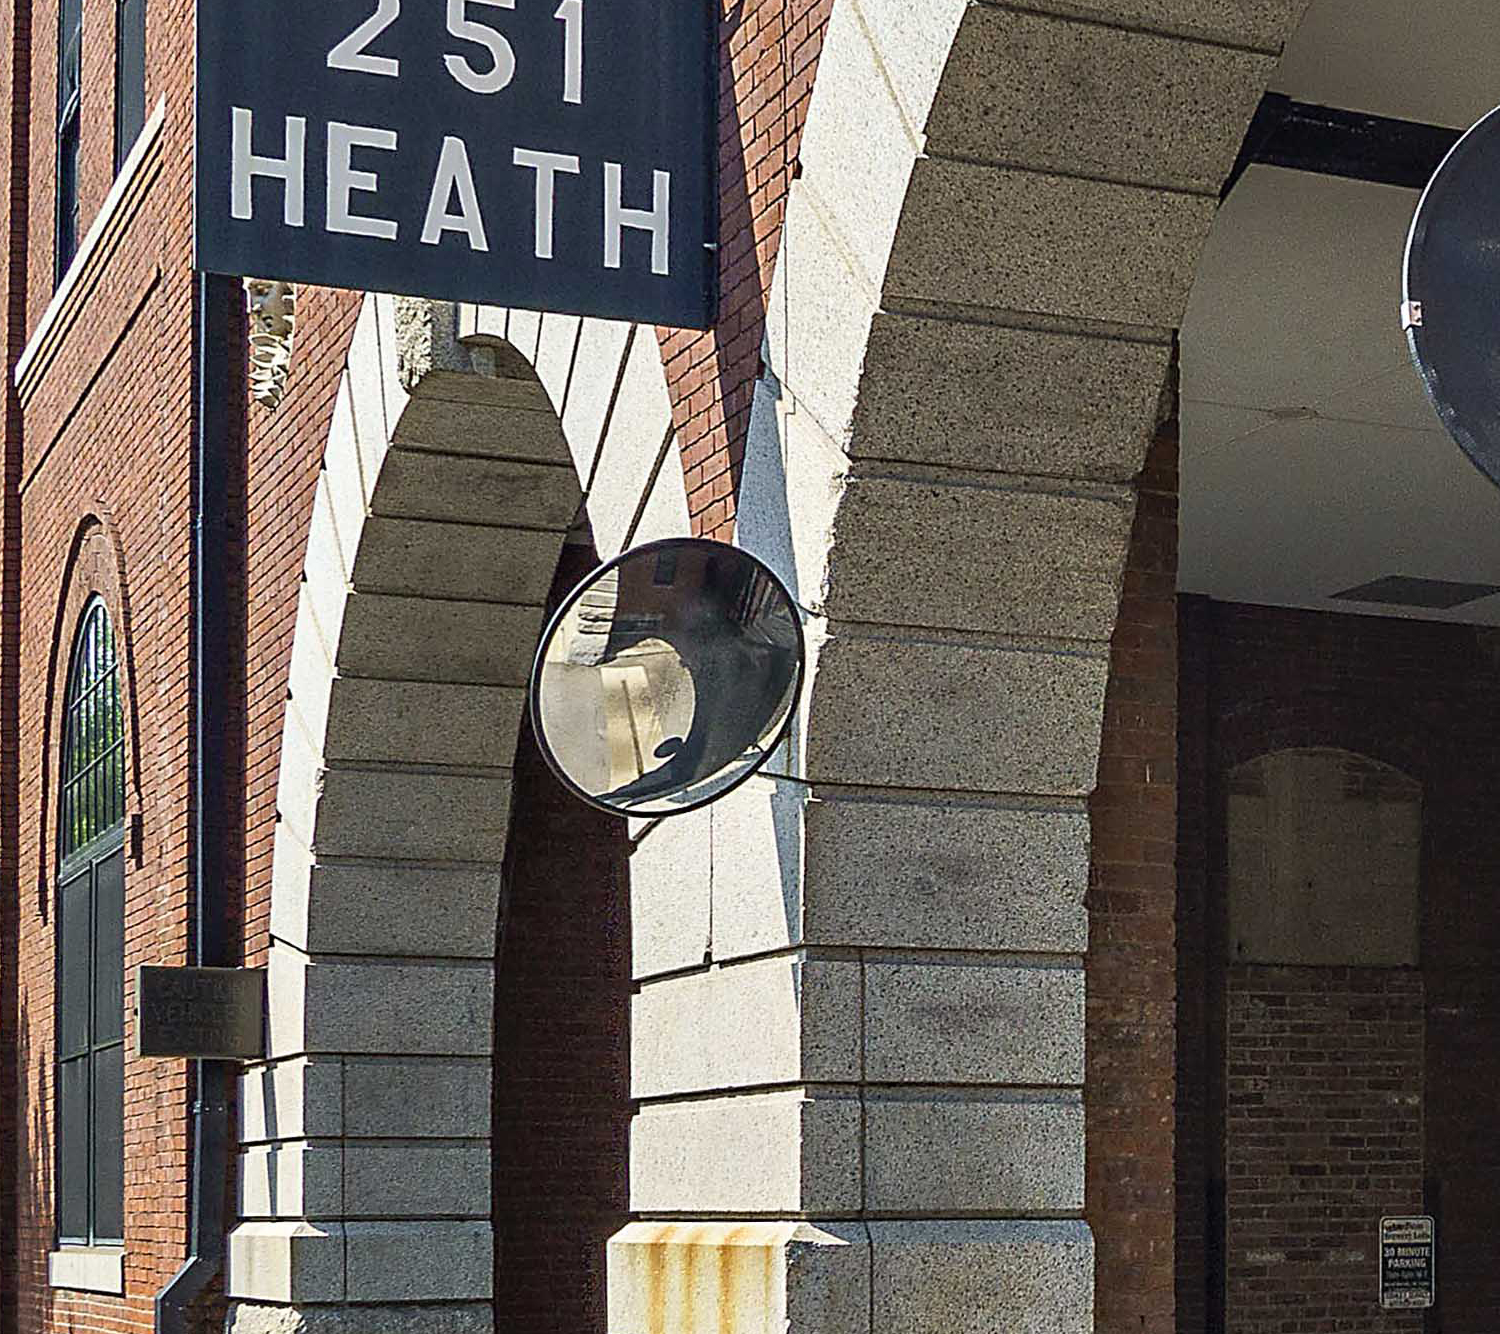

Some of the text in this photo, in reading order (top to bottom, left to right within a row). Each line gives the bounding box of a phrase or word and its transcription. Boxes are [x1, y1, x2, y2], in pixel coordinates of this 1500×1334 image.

[230, 105, 671, 276] HEATH
[1397, 1246, 1431, 1257] MINUTE
[1388, 1258, 1427, 1268] PARKING
